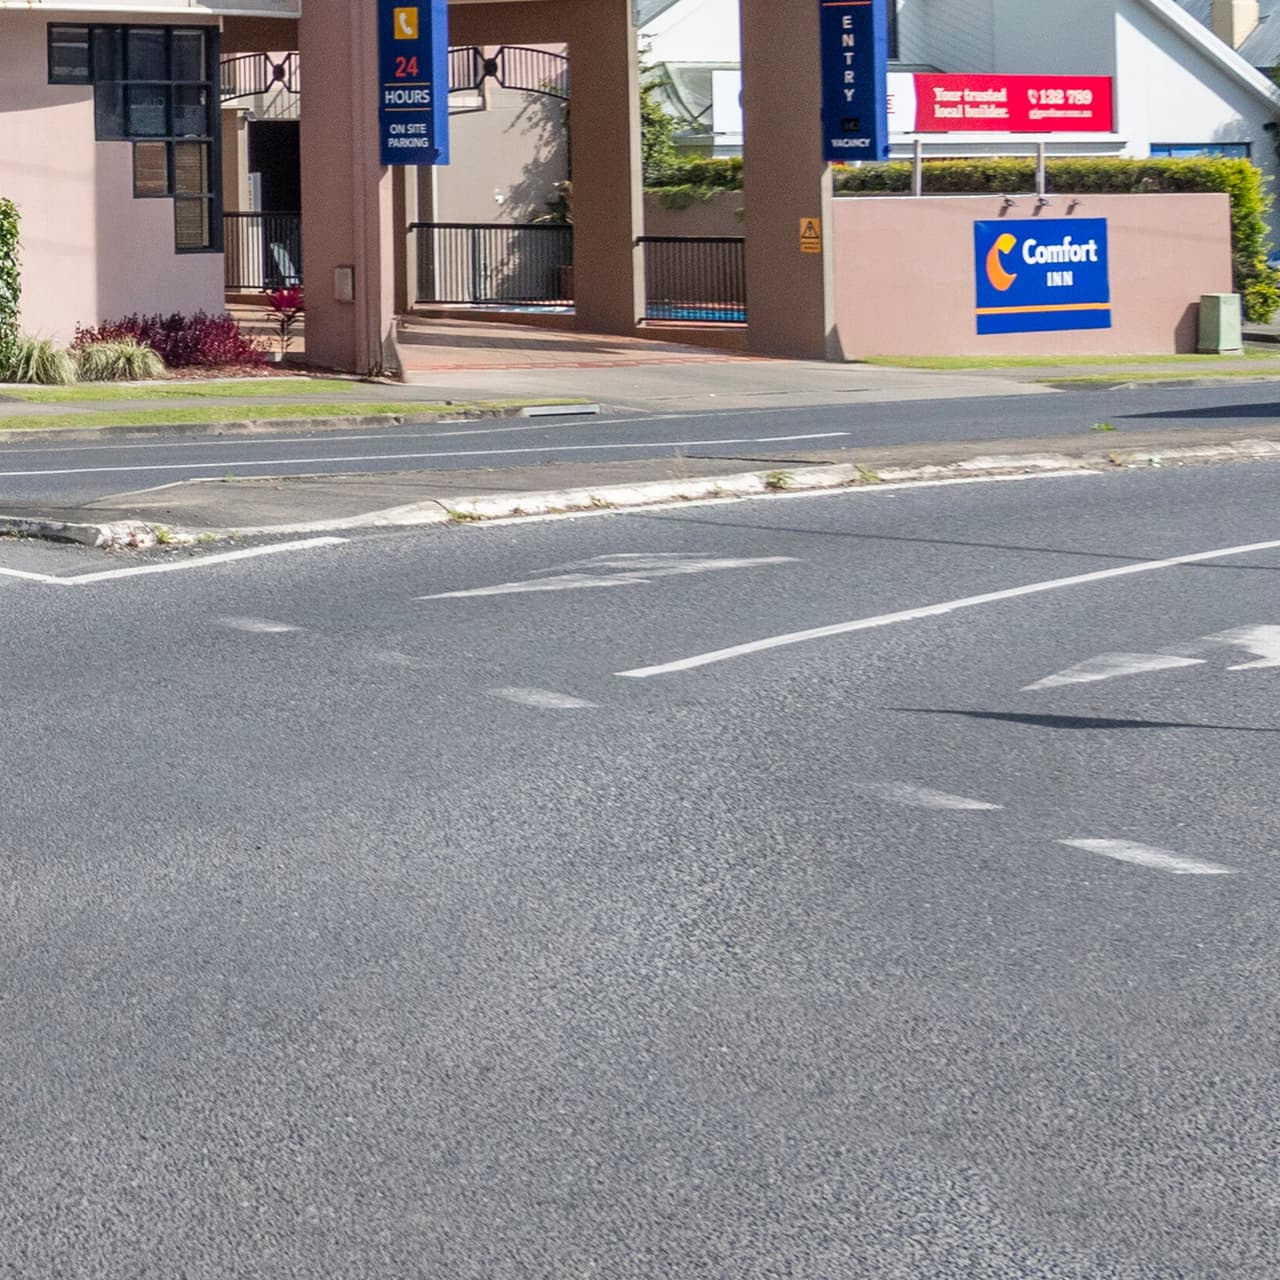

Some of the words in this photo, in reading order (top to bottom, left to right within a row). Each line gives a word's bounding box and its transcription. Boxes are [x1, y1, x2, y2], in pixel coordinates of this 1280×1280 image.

[841, 15, 856, 102] ENTRY
[394, 56, 418, 78] 24
[384, 89, 431, 104] HOURS
[933, 87, 962, 101] Your
[964, 87, 1008, 101] trusted
[1066, 89, 1093, 104] 789
[934, 104, 964, 118] local
[389, 123, 406, 134] ON
[407, 123, 427, 134] SITE
[388, 137, 429, 148] PARKING
[831, 138, 871, 148] VACANCY
[1022, 235, 1099, 265] Comfort
[1046, 270, 1074, 287] INN
